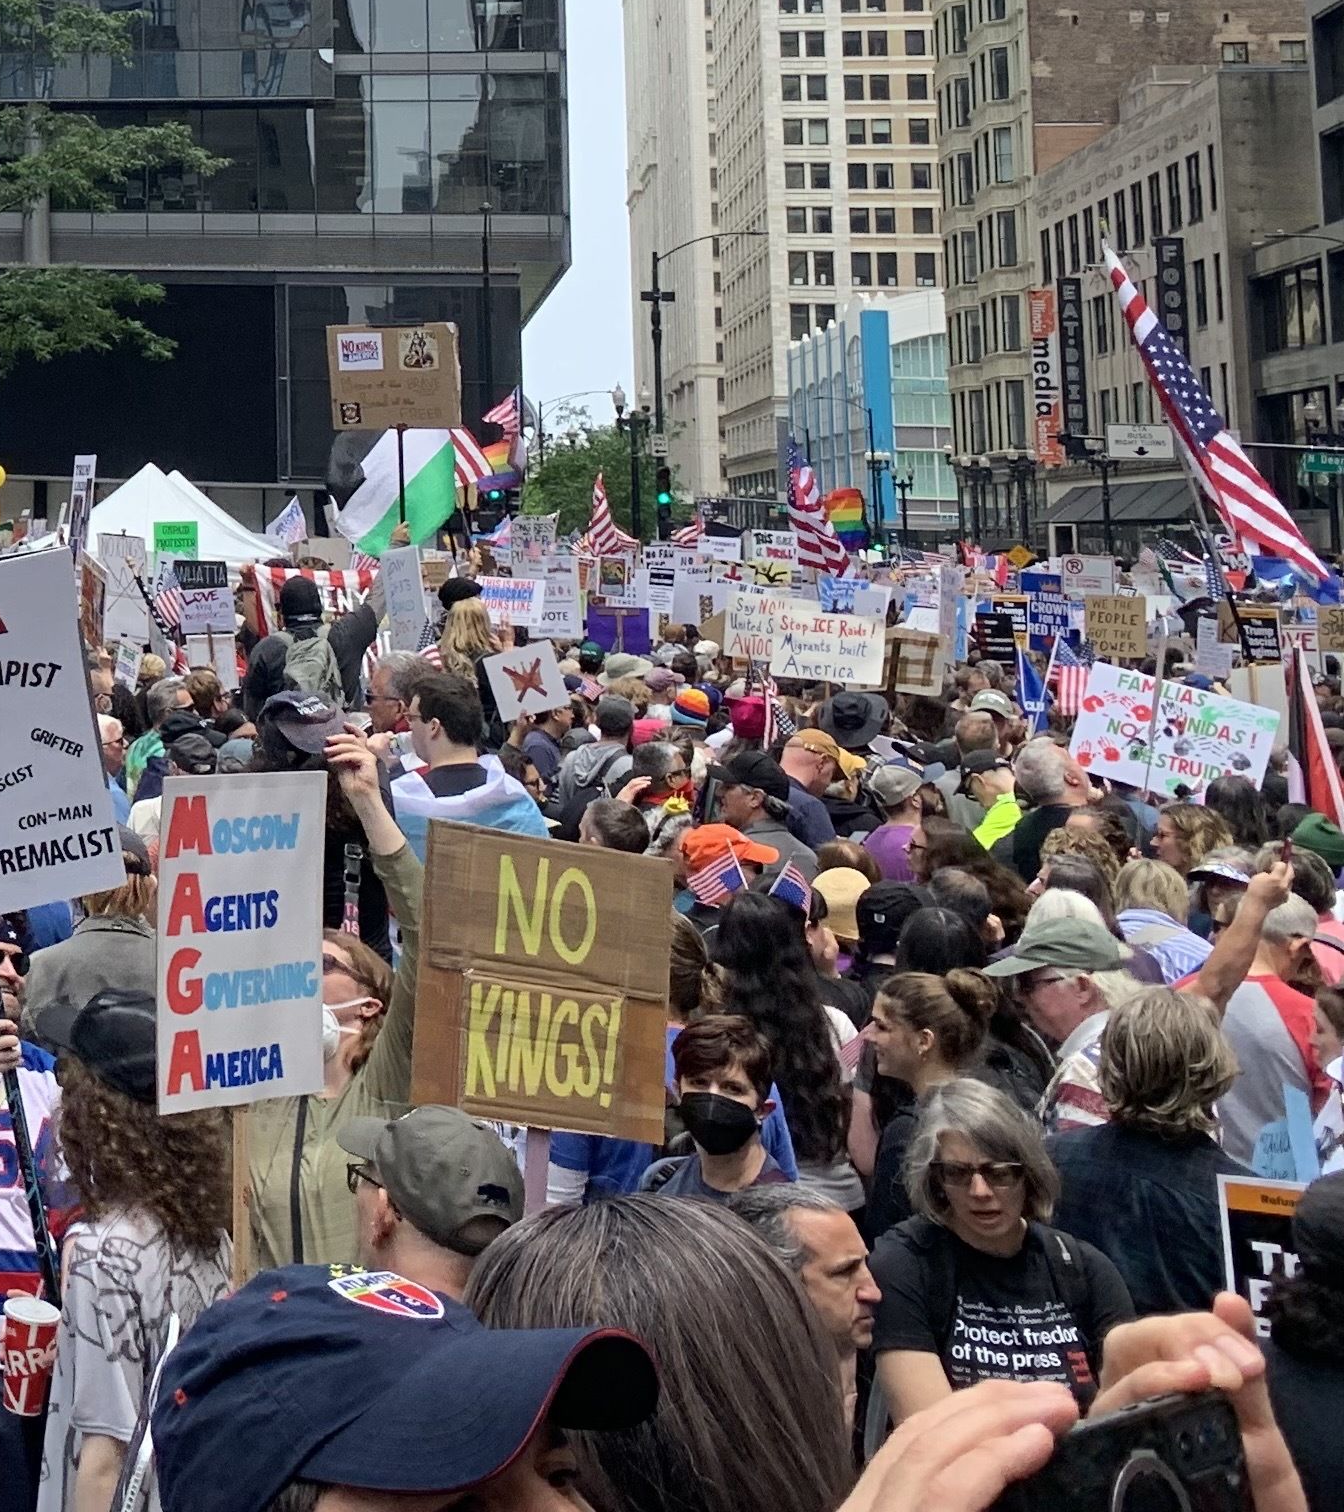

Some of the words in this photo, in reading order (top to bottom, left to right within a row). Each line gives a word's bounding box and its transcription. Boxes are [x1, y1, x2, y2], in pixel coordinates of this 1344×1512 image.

[1161, 245, 1182, 331] FOOD
[1031, 299, 1043, 334] Illinois
[341, 340, 354, 353] NO
[356, 341, 378, 351] KINGS
[1032, 338, 1058, 417] media
[1036, 417, 1051, 455] School
[163, 526, 189, 535] UNPAID
[754, 533, 773, 545] THIS
[156, 539, 195, 548] PROTESTER
[178, 565, 226, 584] WHATTA
[482, 578, 501, 586] THIS
[503, 579, 510, 587] IS
[512, 579, 535, 589] WHAT
[180, 591, 219, 606] LOVE
[320, 587, 369, 613] ENY
[481, 587, 534, 599] DEMOCRACY
[484, 600, 510, 611] OOKS
[512, 601, 531, 612] LIKE
[736, 597, 755, 616] Say
[996, 606, 1024, 618] Trump
[1031, 602, 1069, 614] CROWN
[1092, 599, 1106, 610] WE
[1114, 599, 1134, 610] THE
[542, 611, 569, 622] VOTE
[730, 612, 762, 634] United
[780, 616, 808, 634] Stop
[812, 617, 834, 634] ICE
[1039, 614, 1053, 624] FOR
[1056, 614, 1062, 624] A
[1090, 612, 1140, 626] PEOPLE
[1028, 623, 1048, 636] RED
[1051, 625, 1070, 639] HAT
[1089, 629, 1108, 638] GOT
[1114, 629, 1132, 639] THE
[1243, 625, 1274, 639] Trump
[730, 634, 772, 657] AUTOC
[780, 634, 831, 655] Migrants
[839, 639, 868, 658] built
[1089, 640, 1137, 654] POWER
[783, 655, 855, 679] America
[1107, 719, 1137, 738] NO
[30, 727, 83, 757] GRIFTER
[1129, 744, 1236, 779] DESTRUIDA
[18, 804, 93, 830] CON-MAN
[495, 854, 597, 965] NO
[465, 982, 623, 1109] KINGS!
[1251, 1241, 1302, 1279] Tr
[954, 1319, 1022, 1346] Protect
[952, 1343, 972, 1361] of
[975, 1345, 1009, 1367] the
